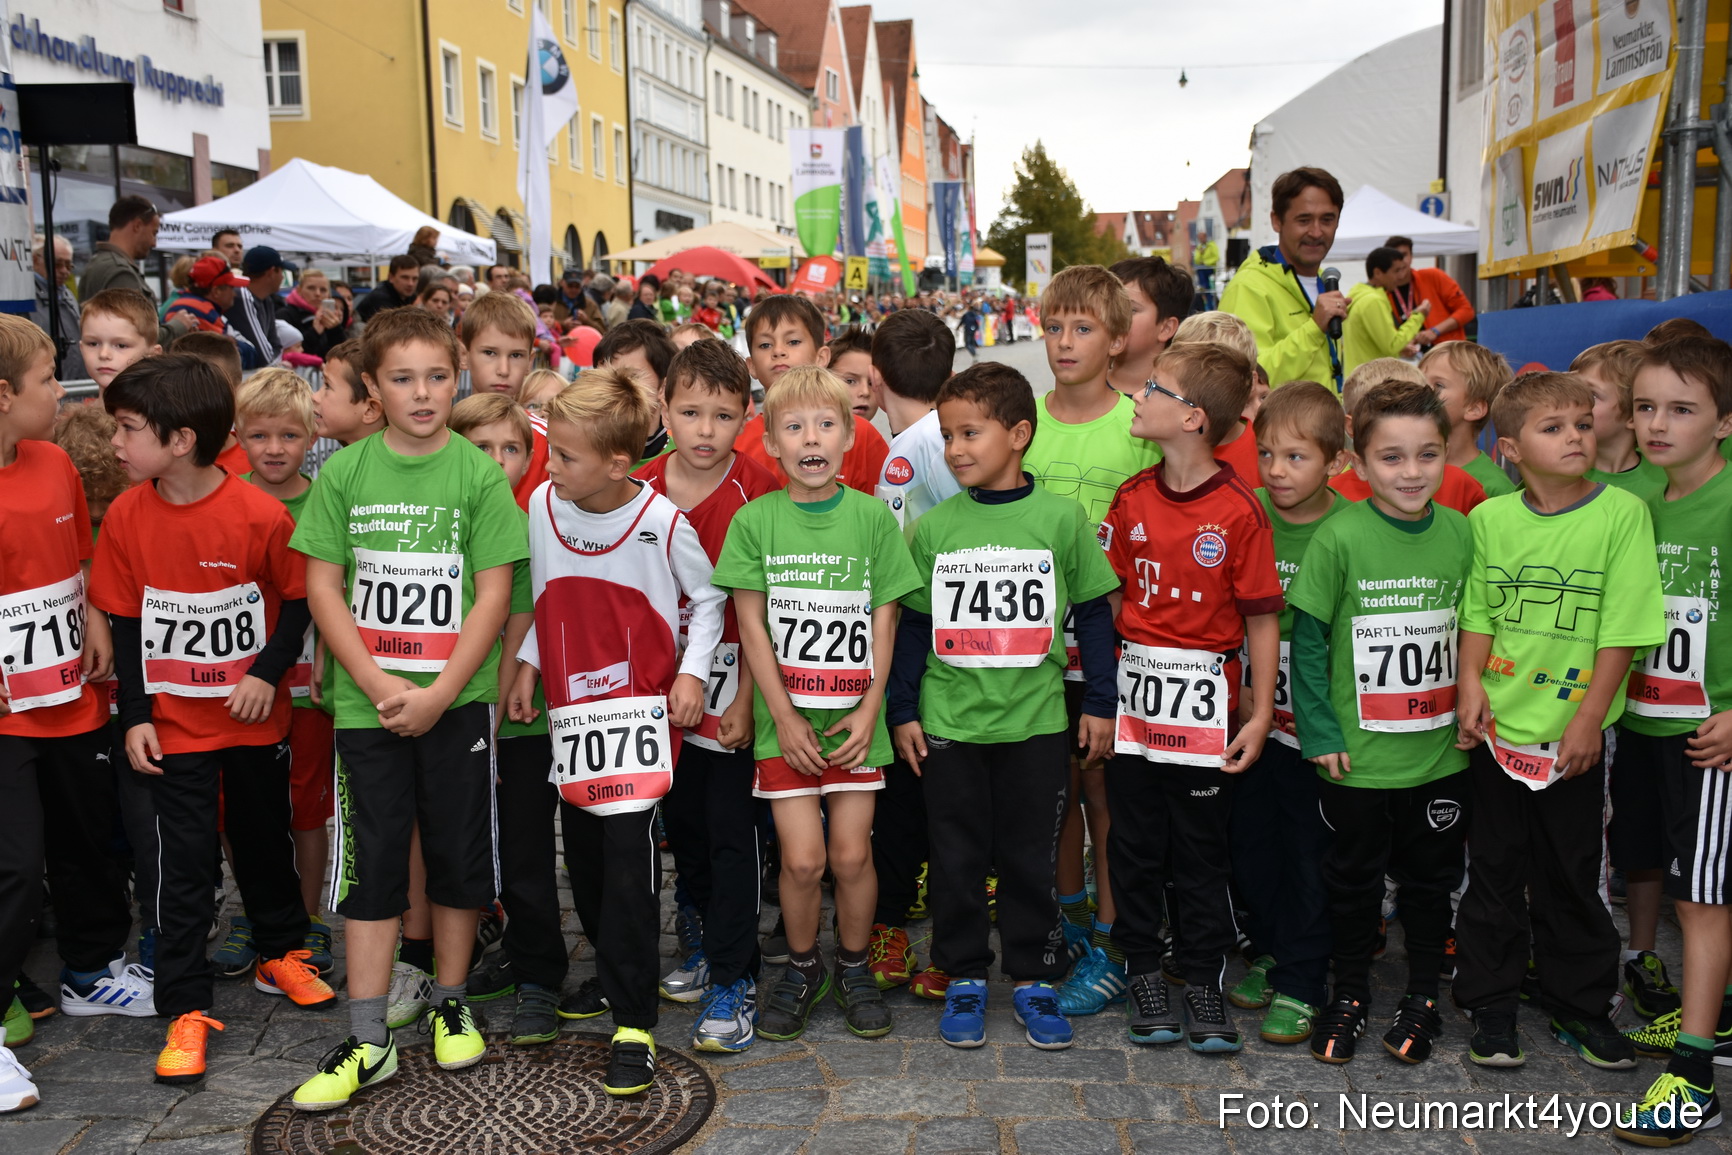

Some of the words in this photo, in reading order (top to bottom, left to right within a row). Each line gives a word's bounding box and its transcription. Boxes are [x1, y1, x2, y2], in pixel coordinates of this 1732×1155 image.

[1612, 20, 1655, 51] Neumarkter
[1605, 38, 1663, 81] Lammsbräu
[137, 54, 224, 108] Rupprecht
[1533, 175, 1564, 212] swn
[160, 223, 180, 233] MW
[851, 267, 862, 281] A
[886, 463, 909, 478] Hervis
[350, 502, 429, 517] Neumarkter
[349, 519, 412, 535] Stadtlauf
[357, 561, 379, 575] PARTL
[382, 564, 443, 577] Neumarkt
[766, 552, 842, 567] Neumarkter
[936, 564, 971, 575] PARTL
[974, 562, 1034, 574] Neumarkt
[766, 569, 825, 584] Stadtlauf
[1358, 576, 1438, 591] Neumarkter
[1709, 546, 1721, 622] BAMBINI
[43, 588, 79, 610] Neumarkt
[146, 598, 185, 614] PARTL
[187, 596, 243, 615] Neumarkt
[359, 579, 453, 627] 7020
[771, 598, 805, 612] PARTL
[807, 601, 861, 614] Neumarkt
[945, 579, 1045, 622] 7436
[9, 602, 86, 666] 7188
[154, 610, 256, 657] 7208
[778, 616, 868, 663] 7226
[1356, 626, 1400, 639] PARTL
[1404, 622, 1449, 636] Neumark
[375, 636, 423, 655] Julian
[956, 629, 996, 656] Paul
[1121, 652, 1146, 668] PARTL
[1148, 658, 1208, 672] Neumarkt
[1368, 637, 1453, 687] 7041
[1486, 654, 1515, 677] ERZ
[191, 667, 227, 684] Luis
[1126, 671, 1216, 722] 7073
[1408, 695, 1437, 715] Paul
[553, 715, 586, 731] PARTL
[588, 708, 646, 724] Neumarkt
[562, 724, 660, 776] 7076
[1505, 752, 1542, 776] Toni
[587, 782, 635, 802] Simon
[1190, 789, 1214, 797] JAKO
